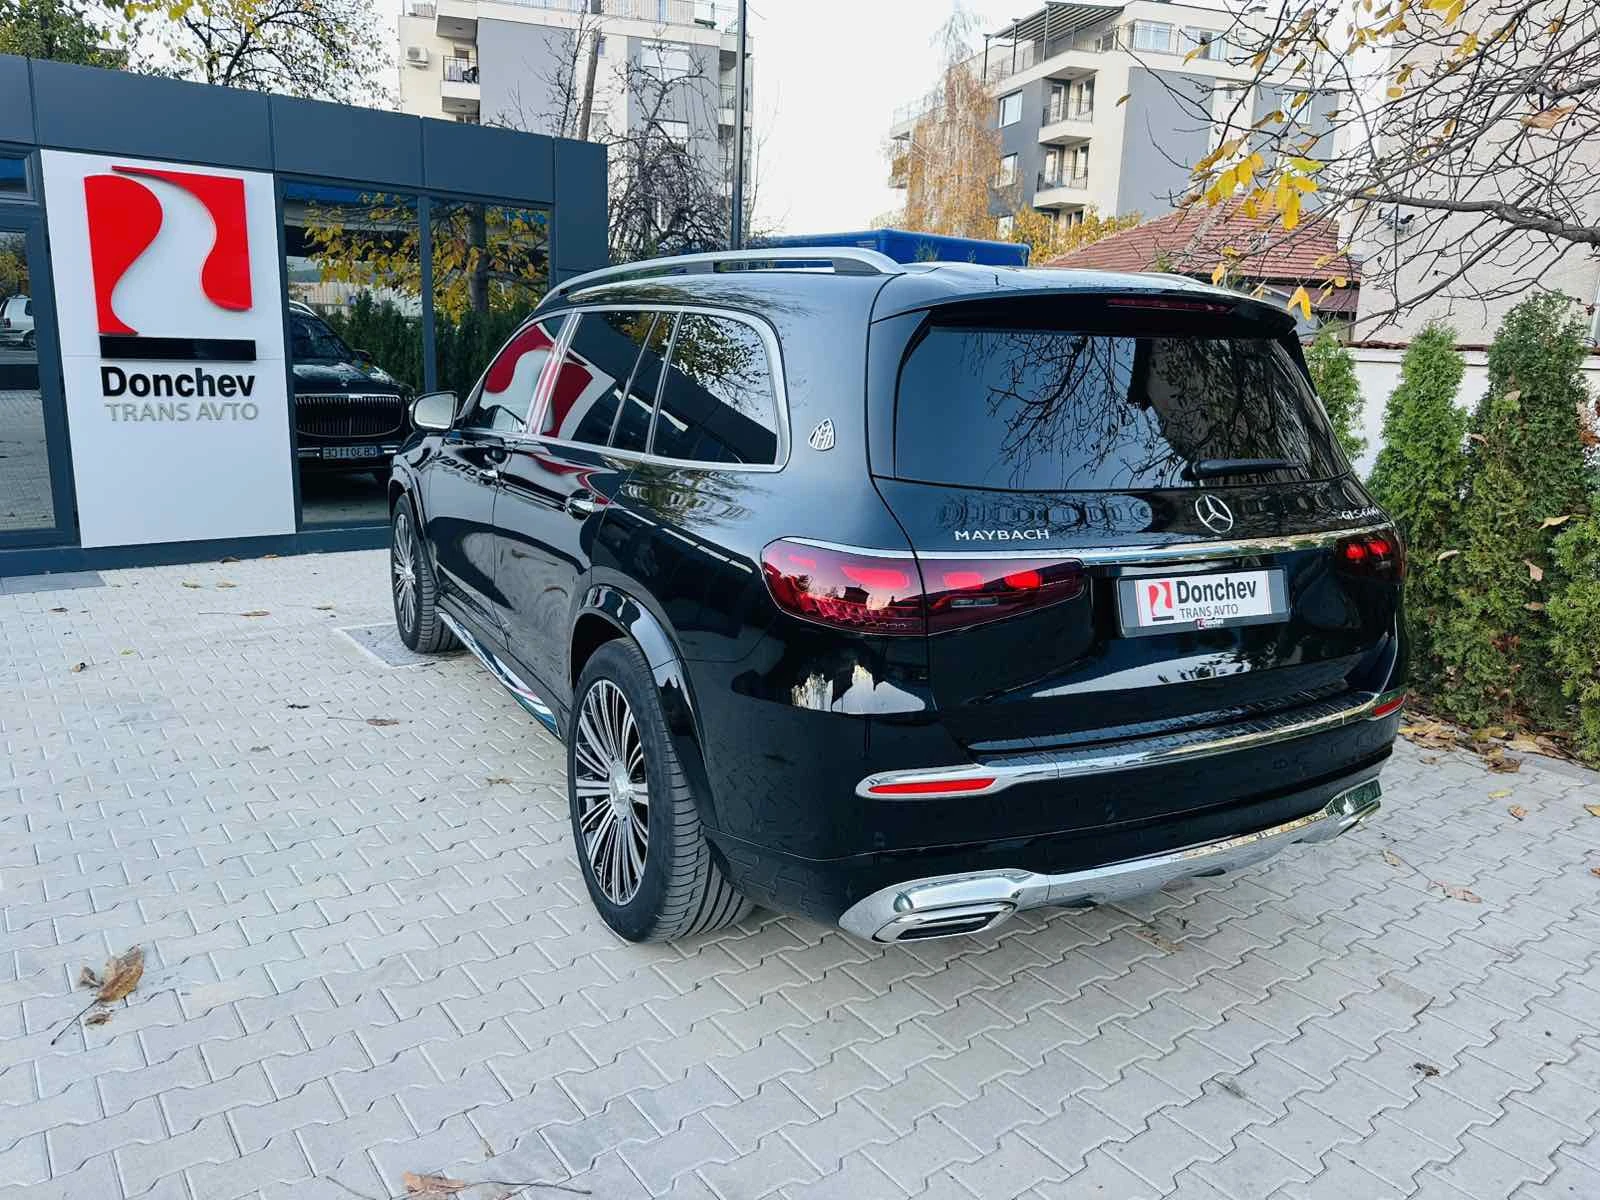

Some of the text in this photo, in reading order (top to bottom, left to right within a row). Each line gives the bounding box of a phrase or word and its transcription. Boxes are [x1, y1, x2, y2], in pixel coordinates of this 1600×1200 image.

[100, 366, 256, 397] Donchev
[104, 402, 259, 422] TRANS AVTO
[954, 528, 1050, 541] MAYBACH
[1175, 576, 1257, 604] Donchev
[1179, 603, 1239, 619] TRANS AVTO
